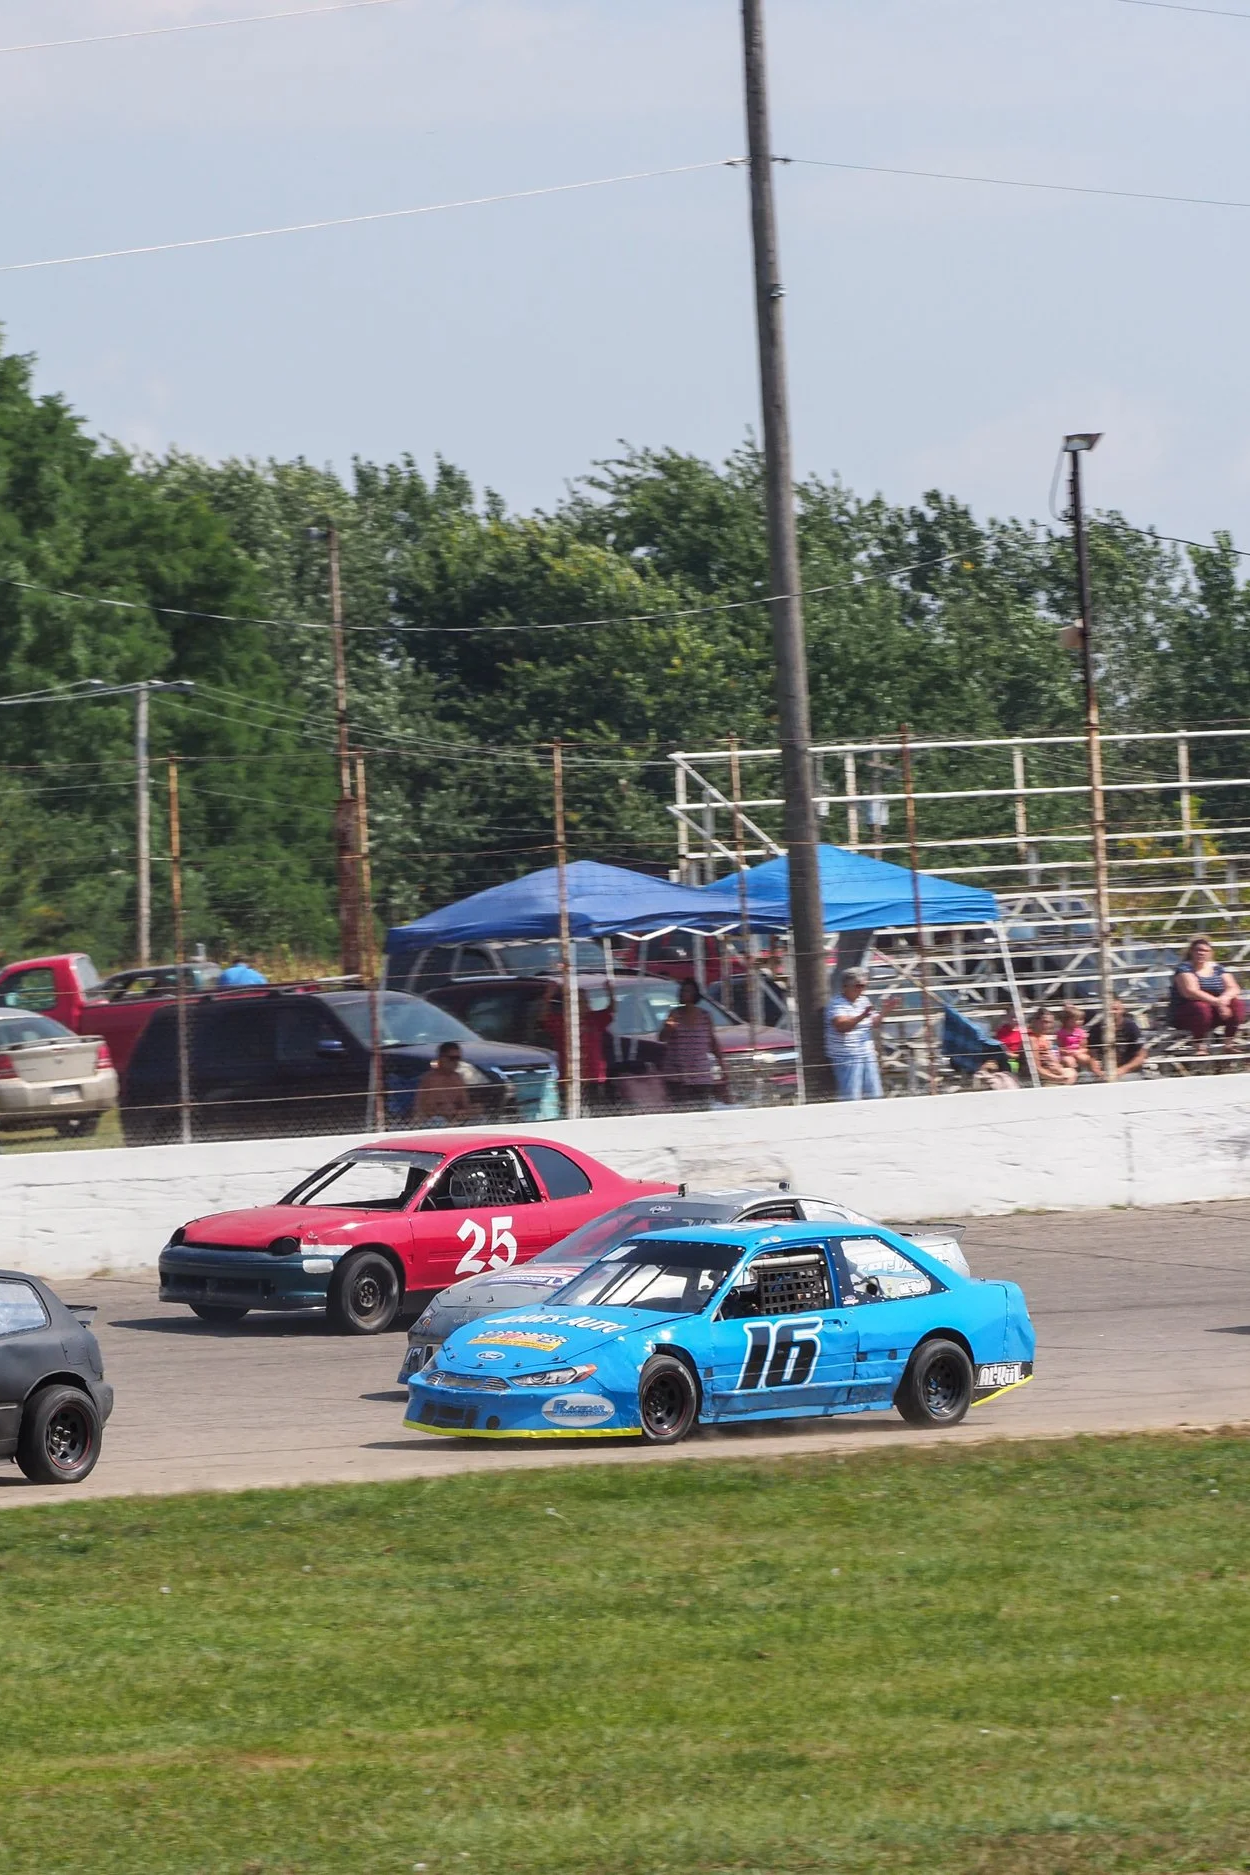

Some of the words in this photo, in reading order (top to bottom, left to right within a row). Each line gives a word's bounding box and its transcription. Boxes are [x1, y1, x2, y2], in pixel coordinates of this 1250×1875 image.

[455, 1216, 517, 1275] 25
[556, 1316, 628, 1333] AUTO
[736, 1316, 823, 1389] 16
